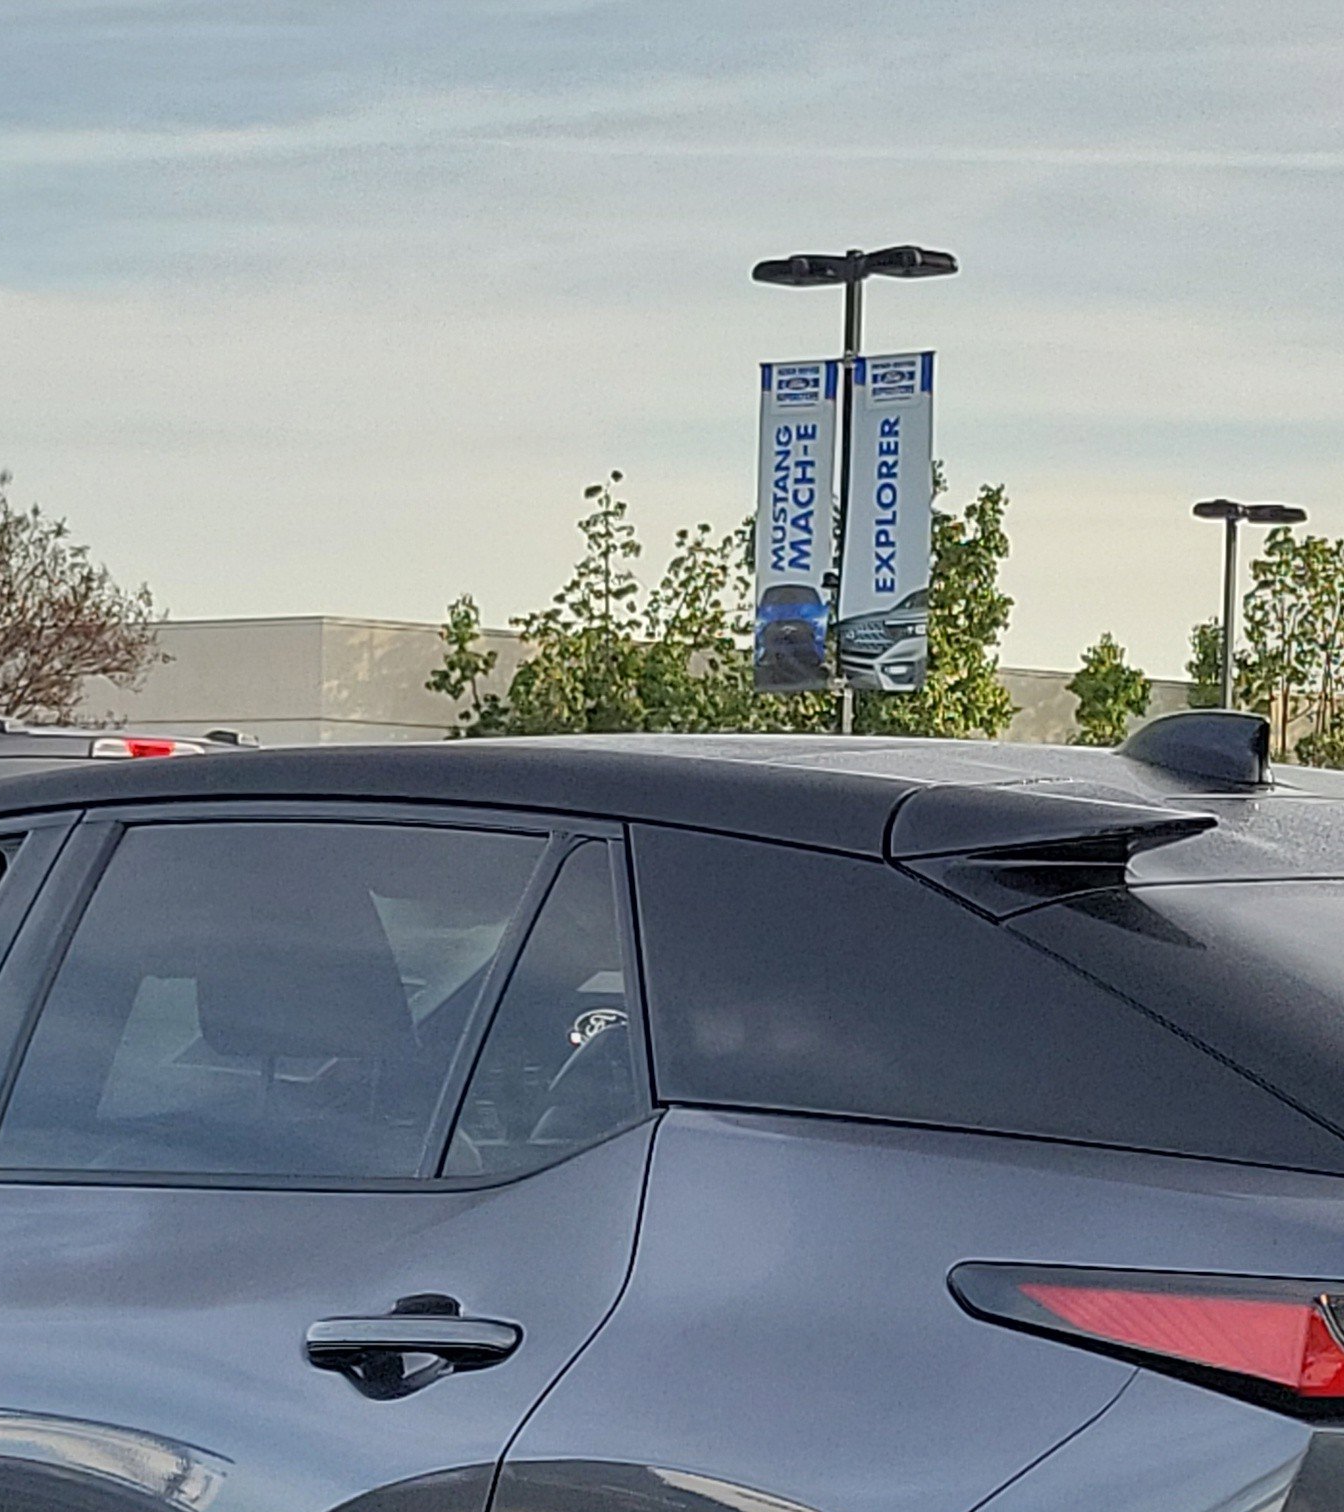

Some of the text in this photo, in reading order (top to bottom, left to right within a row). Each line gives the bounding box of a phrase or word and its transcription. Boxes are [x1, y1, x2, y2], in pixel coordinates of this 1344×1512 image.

[771, 425, 793, 571] MUSTANG
[788, 423, 818, 571] MACH-E
[874, 416, 901, 594] EXPLORER
